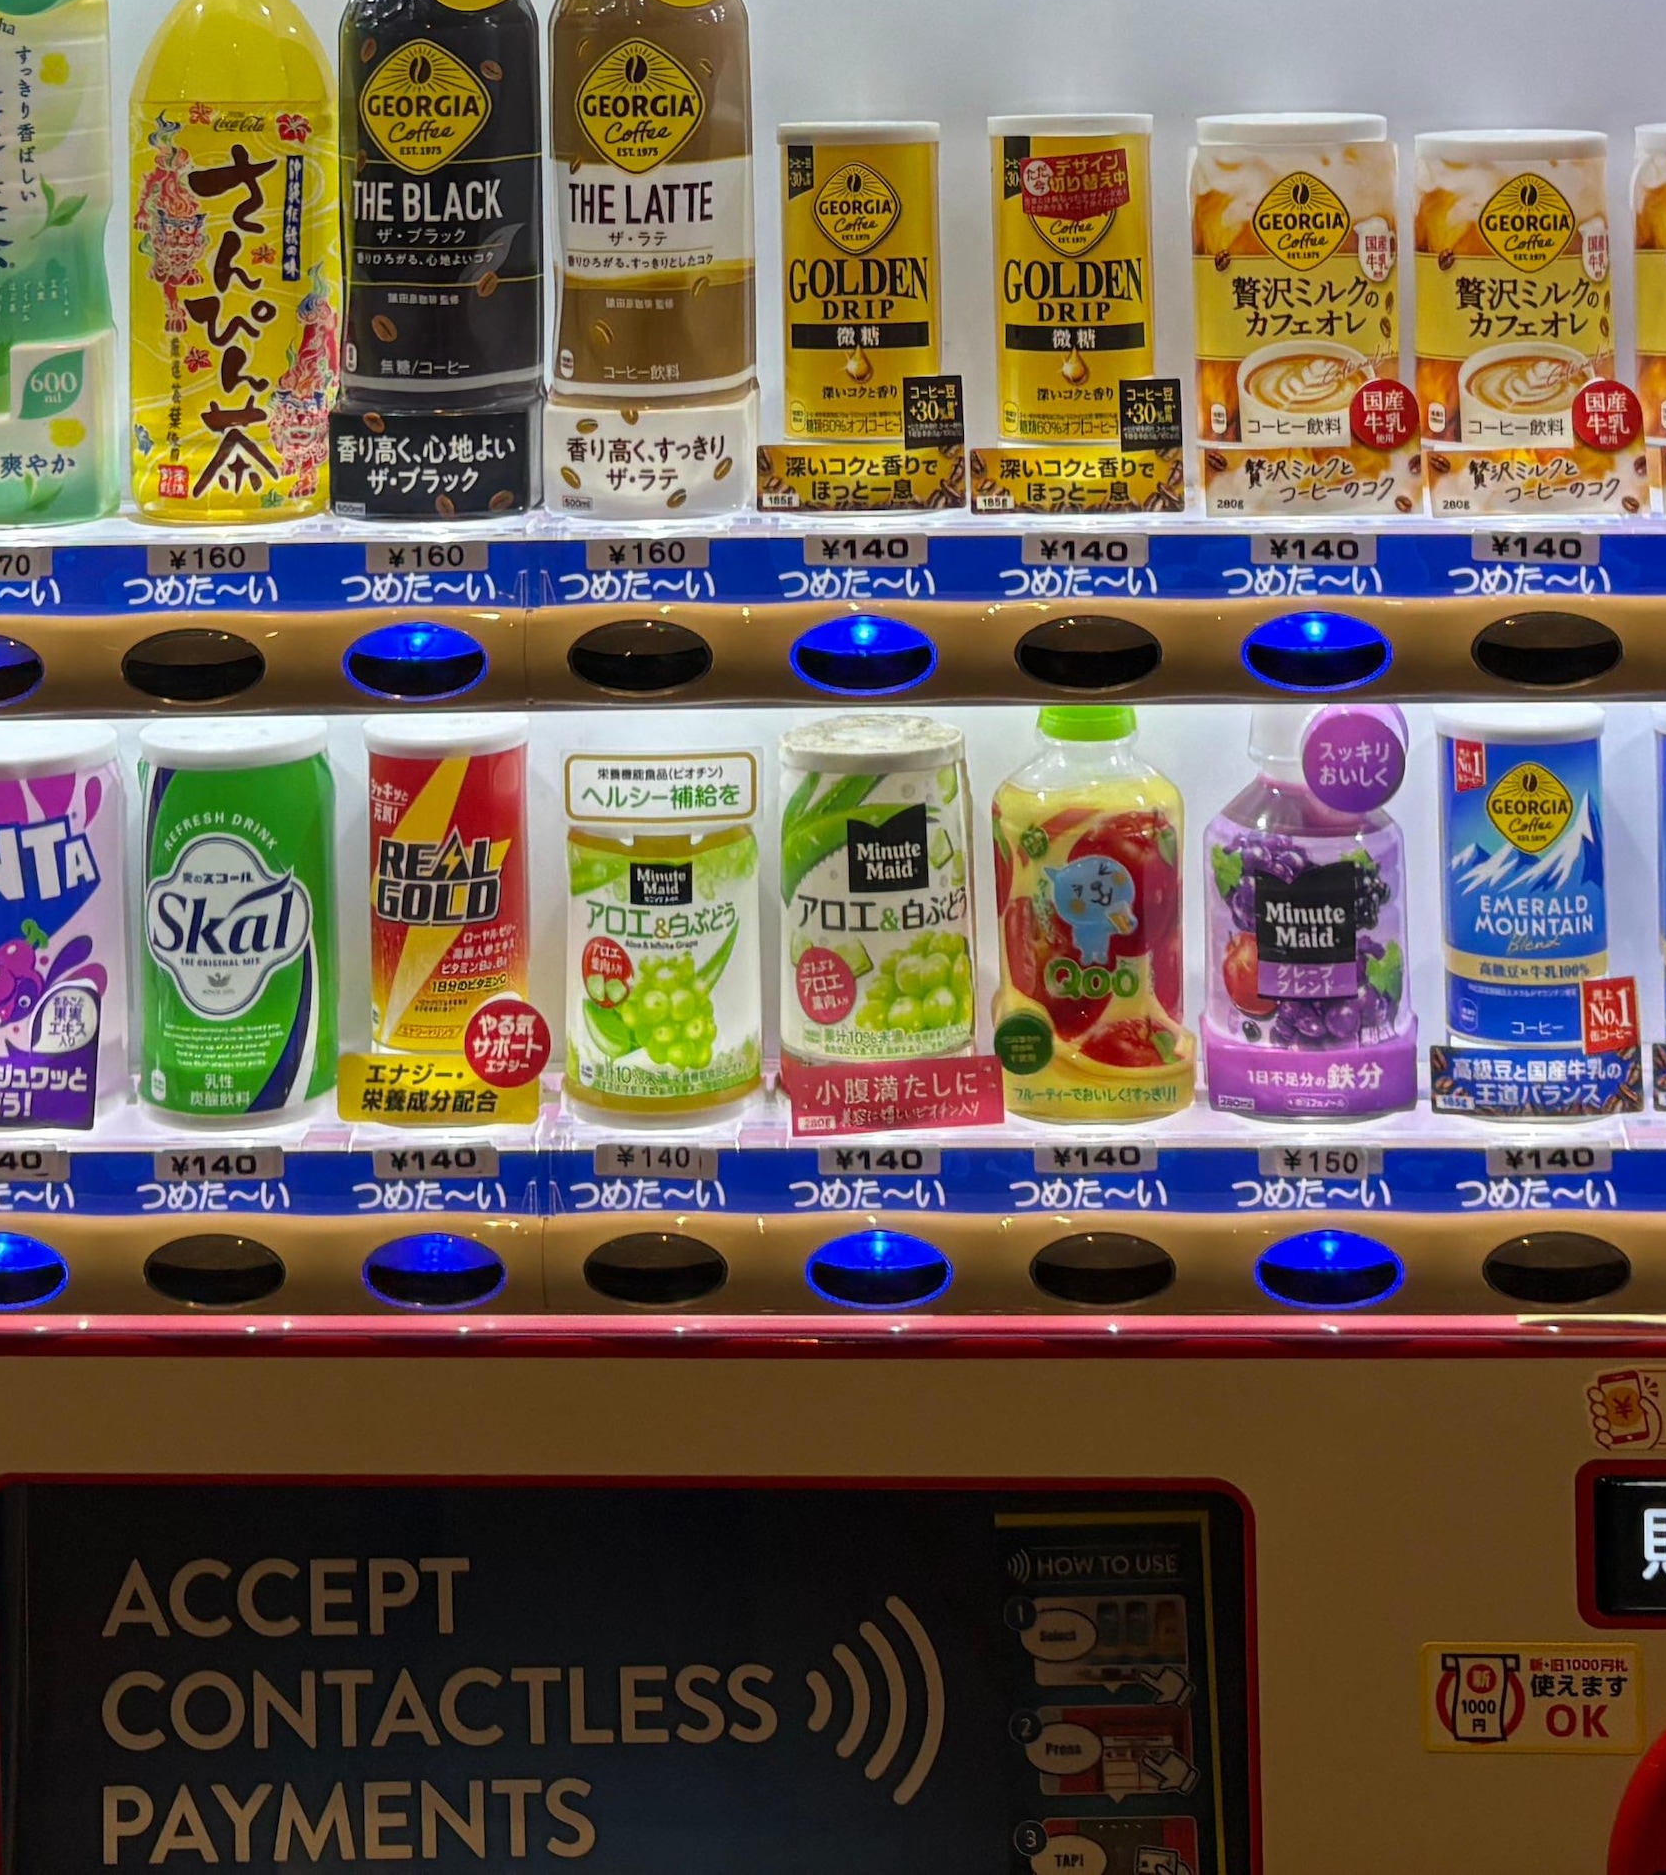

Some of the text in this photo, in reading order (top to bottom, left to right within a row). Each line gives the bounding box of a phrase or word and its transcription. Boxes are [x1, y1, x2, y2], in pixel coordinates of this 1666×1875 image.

[367, 94, 481, 119] GEORGIA
[353, 179, 504, 223] THE BLACK
[569, 180, 714, 224] THE LATTE
[376, 226, 467, 244] ザ・ブラック
[608, 230, 669, 247] ザ・ラテ
[788, 257, 928, 303] GOLDEN
[1232, 270, 1379, 310] 贅沢ミルクの
[187, 145, 282, 498] さんぴん茶
[822, 300, 895, 321] DRIP
[1245, 311, 1368, 338] カフェオレ
[603, 363, 681, 382] コーヒー飲料
[336, 434, 516, 465] 香り高く、心地よい
[566, 435, 727, 465] 香り高く、すっきり
[784, 455, 937, 479] 深いコクと香りで
[170, 546, 246, 569] ¥160
[821, 538, 909, 561] ¥140
[1269, 537, 1360, 561] ¥140
[1318, 740, 1390, 764] スッキリ
[580, 782, 741, 808] ヘルシー補給を
[162, 811, 277, 852] REFRESH DRINK
[378, 826, 501, 880] REAL
[856, 839, 922, 864] Minute
[864, 859, 918, 882] Maid
[376, 877, 503, 925] GOLD
[797, 886, 969, 932] アロエ&白ぶどう
[1480, 894, 1589, 916] EMERALD
[1474, 913, 1594, 936] MOUNTAIN
[1044, 957, 1139, 999] Qoo
[477, 1013, 535, 1037] やる気
[1588, 1000, 1630, 1028] No.1
[472, 1036, 543, 1058] サポート
[1247, 1061, 1384, 1092] 1日不足分の鉄分
[1452, 1056, 1622, 1084] 高級豆と国産牛乳の
[189, 1089, 251, 1107] 炭酸飲料
[361, 1087, 499, 1113] 栄養成分配合
[814, 1069, 978, 1106] 小腹満たしに
[1474, 1081, 1602, 1108] 王道バランス
[1037, 1553, 1177, 1575] HOW TO USE
[101, 1557, 470, 1637] ACCEPT
[1531, 1674, 1627, 1698] 使えます
[101, 1664, 778, 1751] CONTACTLESS
[1461, 1699, 1496, 1715] 1000
[1547, 1703, 1609, 1738] OK
[102, 1777, 596, 1865] PAYMENTS
